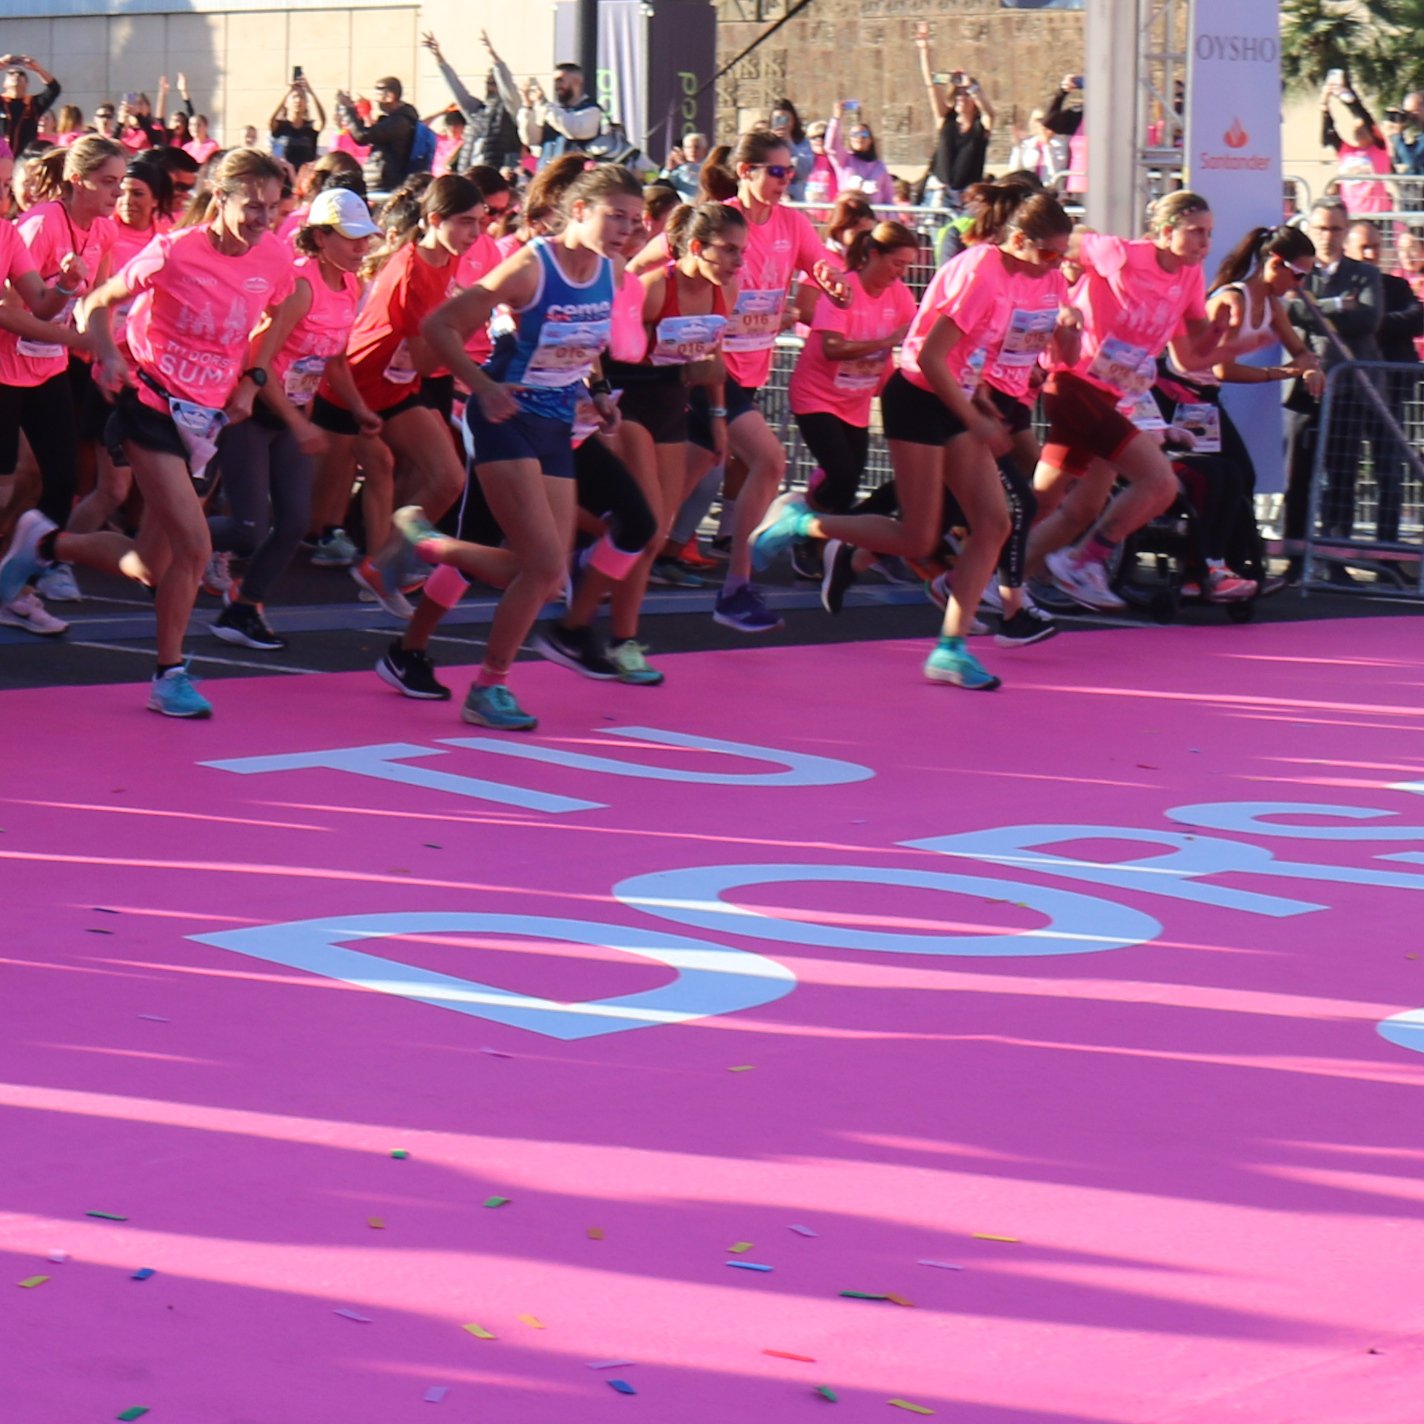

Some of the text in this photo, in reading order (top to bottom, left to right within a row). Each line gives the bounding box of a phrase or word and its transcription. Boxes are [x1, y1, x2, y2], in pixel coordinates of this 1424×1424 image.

[1196, 33, 1276, 63] OYSHO
[1200, 150, 1271, 172] Santander
[743, 314, 769, 325] 016
[197, 726, 877, 814] TU
